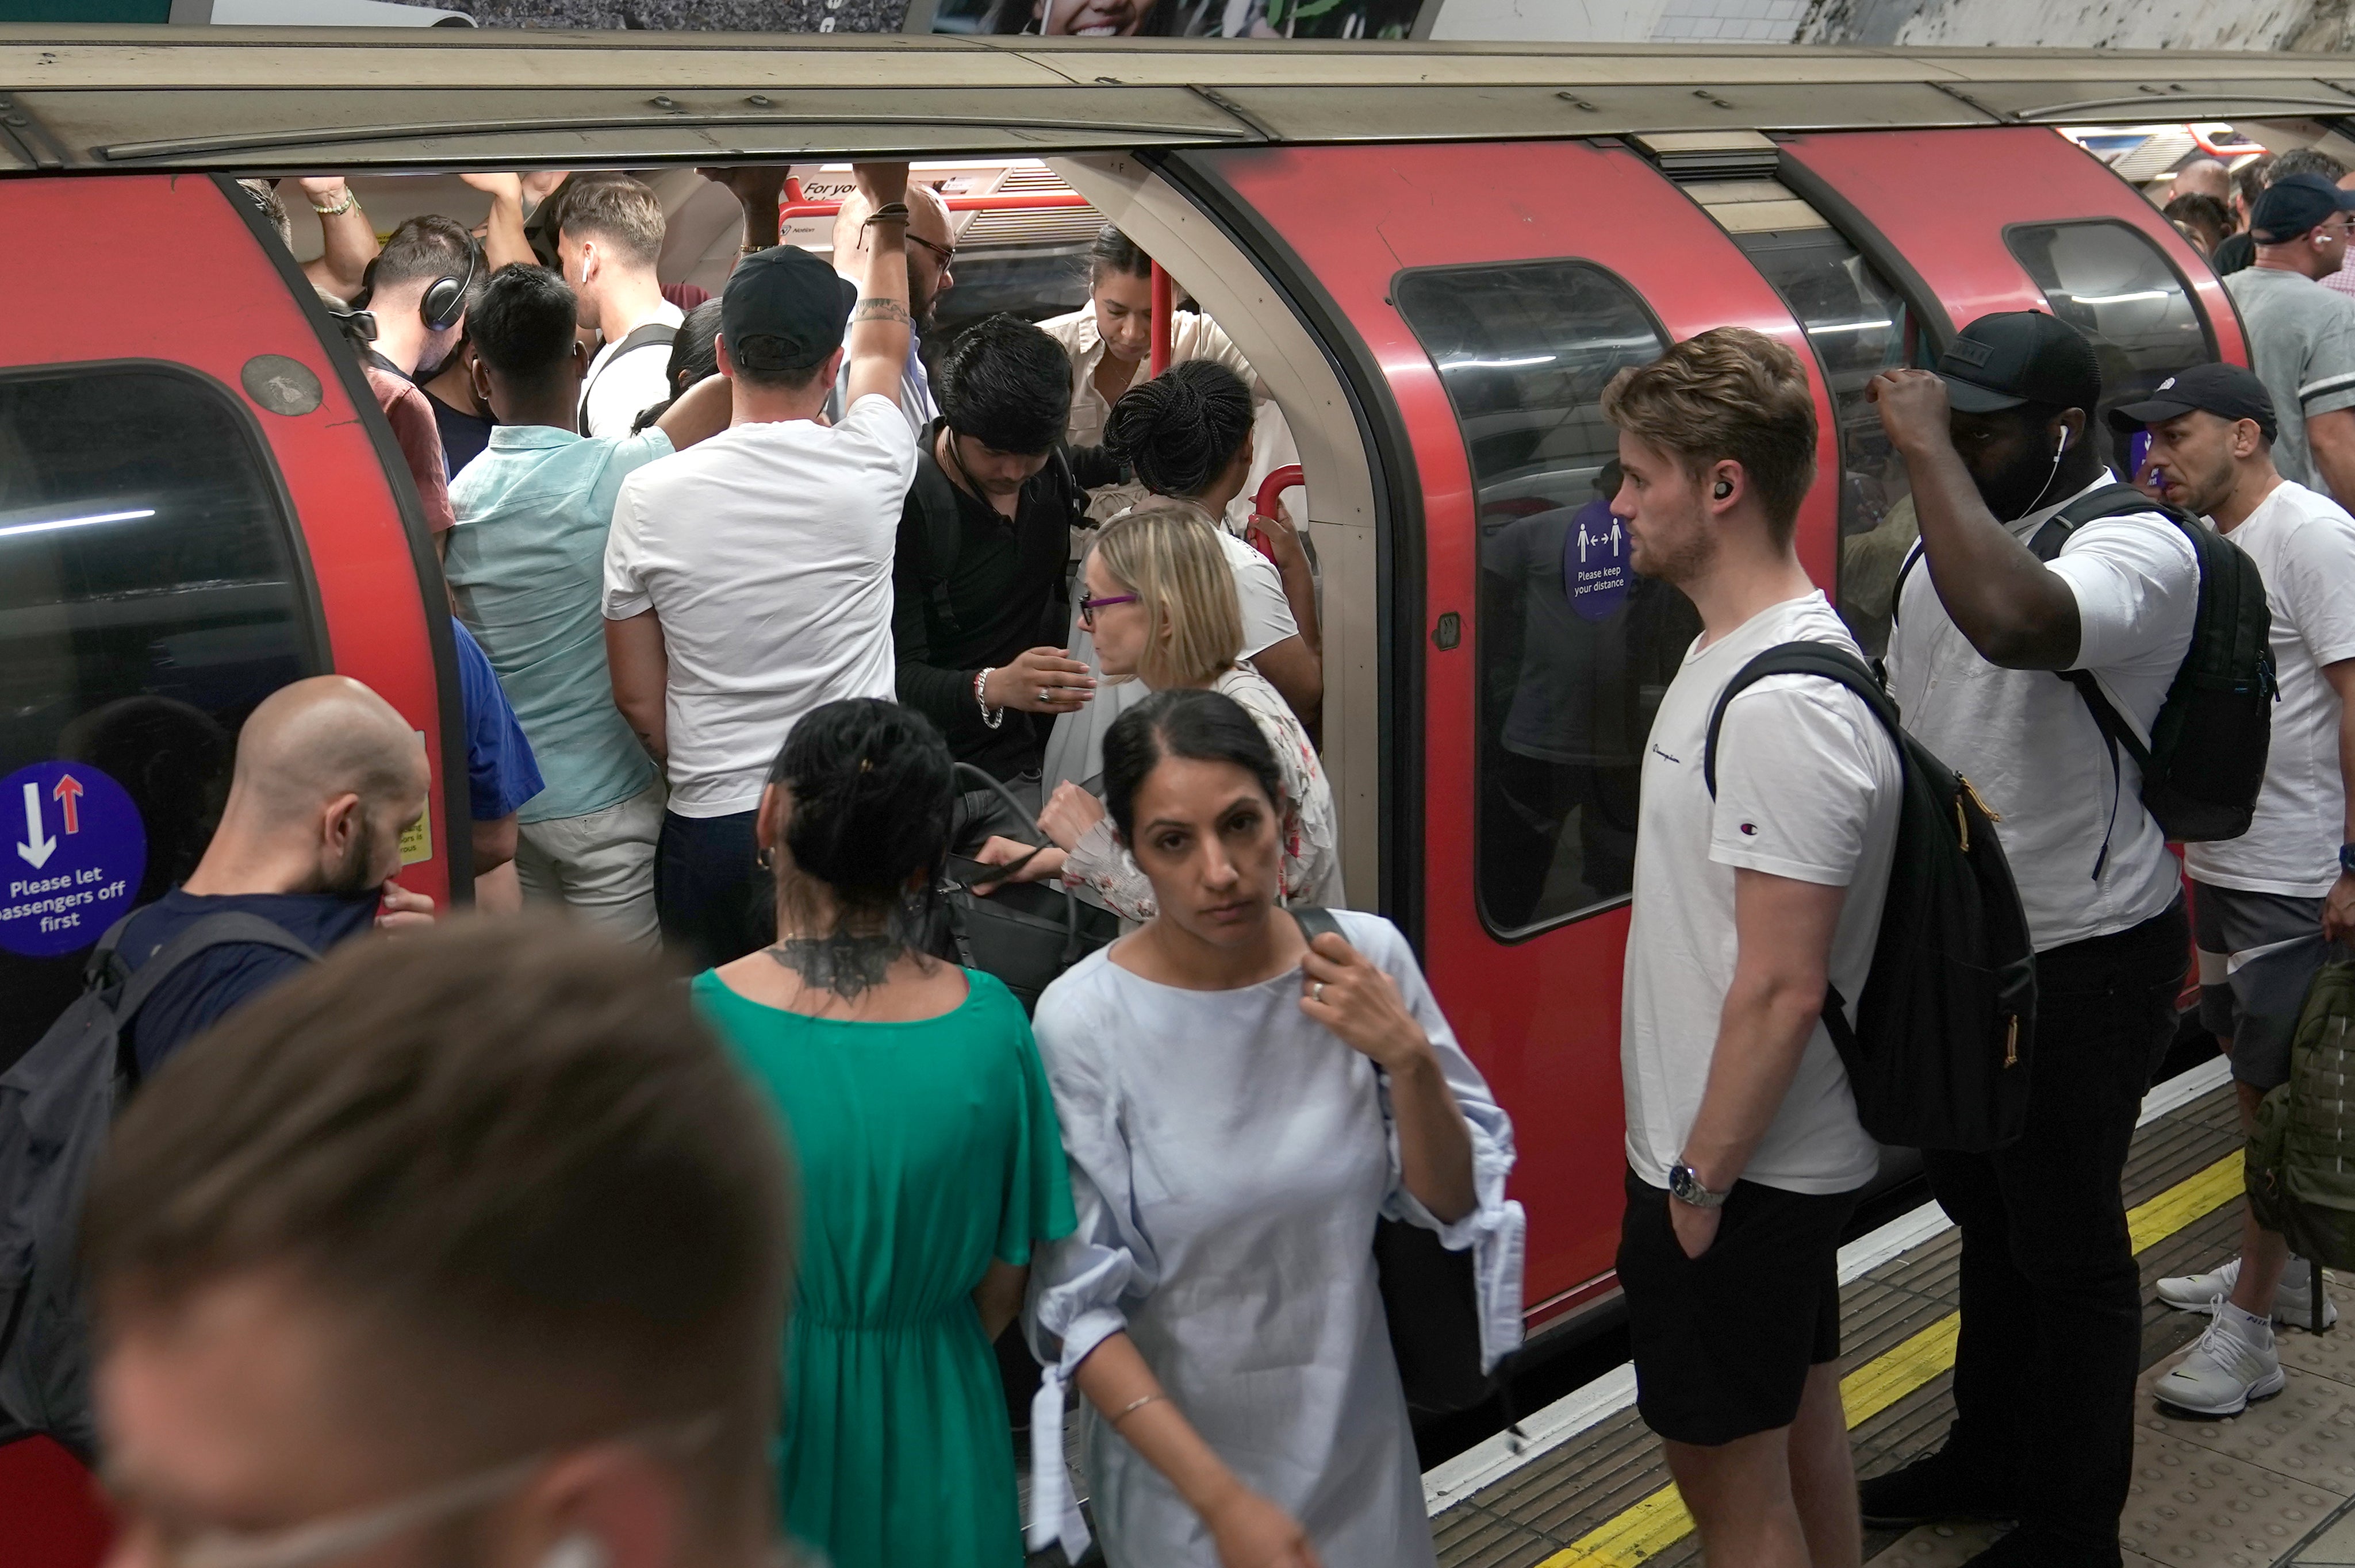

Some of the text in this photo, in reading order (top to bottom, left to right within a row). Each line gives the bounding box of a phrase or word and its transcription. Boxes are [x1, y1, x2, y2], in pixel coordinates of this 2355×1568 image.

[804, 183, 833, 194] For
[1578, 566, 1621, 582] Please keep
[1574, 578, 1624, 597] your distance
[10, 867, 103, 899] Please let
[97, 880, 126, 901] off
[39, 912, 81, 933] first
